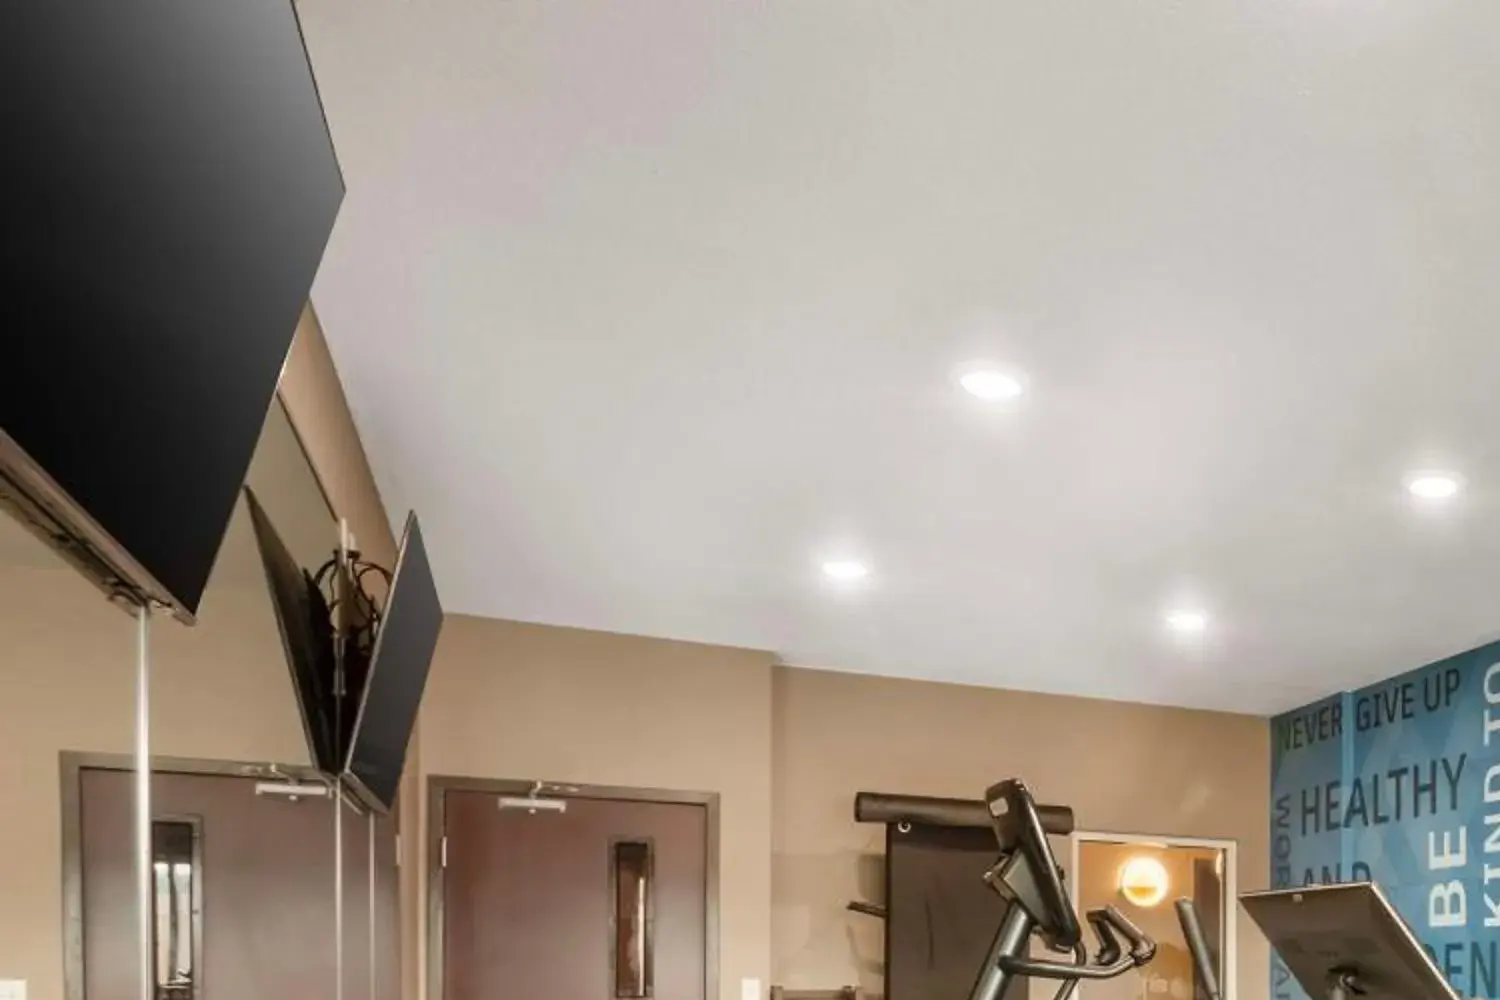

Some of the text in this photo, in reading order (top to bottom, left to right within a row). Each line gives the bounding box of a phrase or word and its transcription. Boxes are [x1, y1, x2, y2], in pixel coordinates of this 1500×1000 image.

[1279, 667, 1460, 751] NEVER GIVE UP
[1301, 752, 1467, 838] HEALTHY
[1275, 794, 1291, 888] WOR
[1428, 825, 1467, 927] BE
